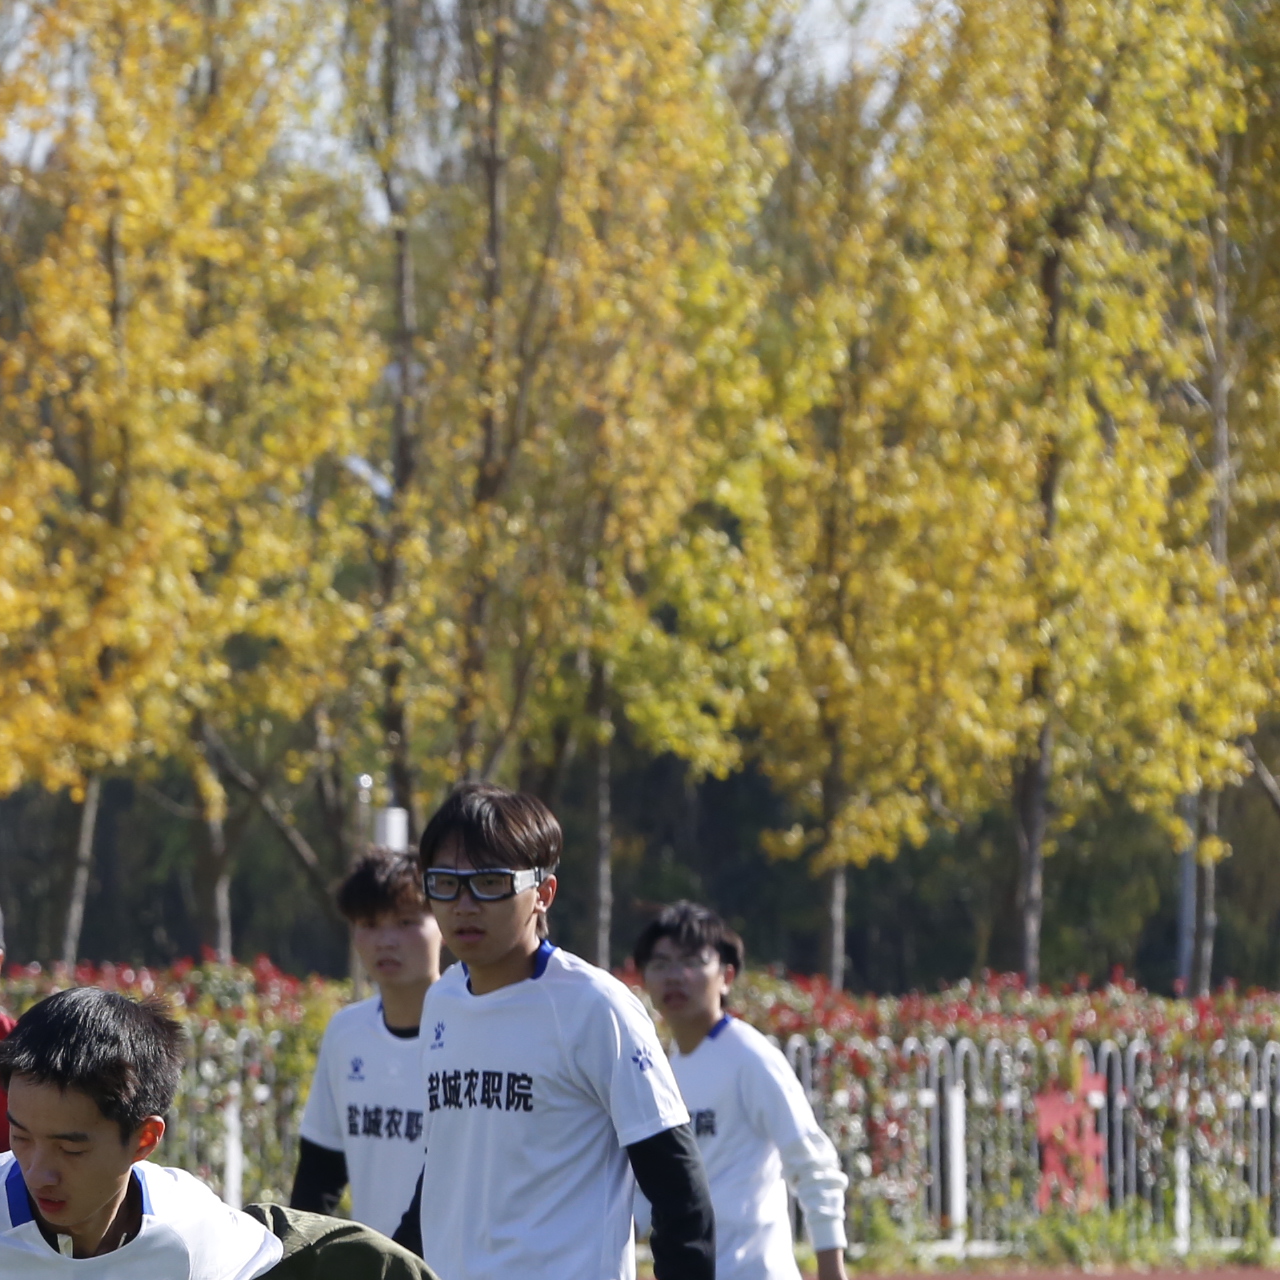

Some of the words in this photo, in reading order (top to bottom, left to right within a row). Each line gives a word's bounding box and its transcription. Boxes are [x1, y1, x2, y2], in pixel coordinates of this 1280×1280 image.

[427, 1068, 534, 1112] 盐城农职院
[689, 1107, 716, 1138] 院
